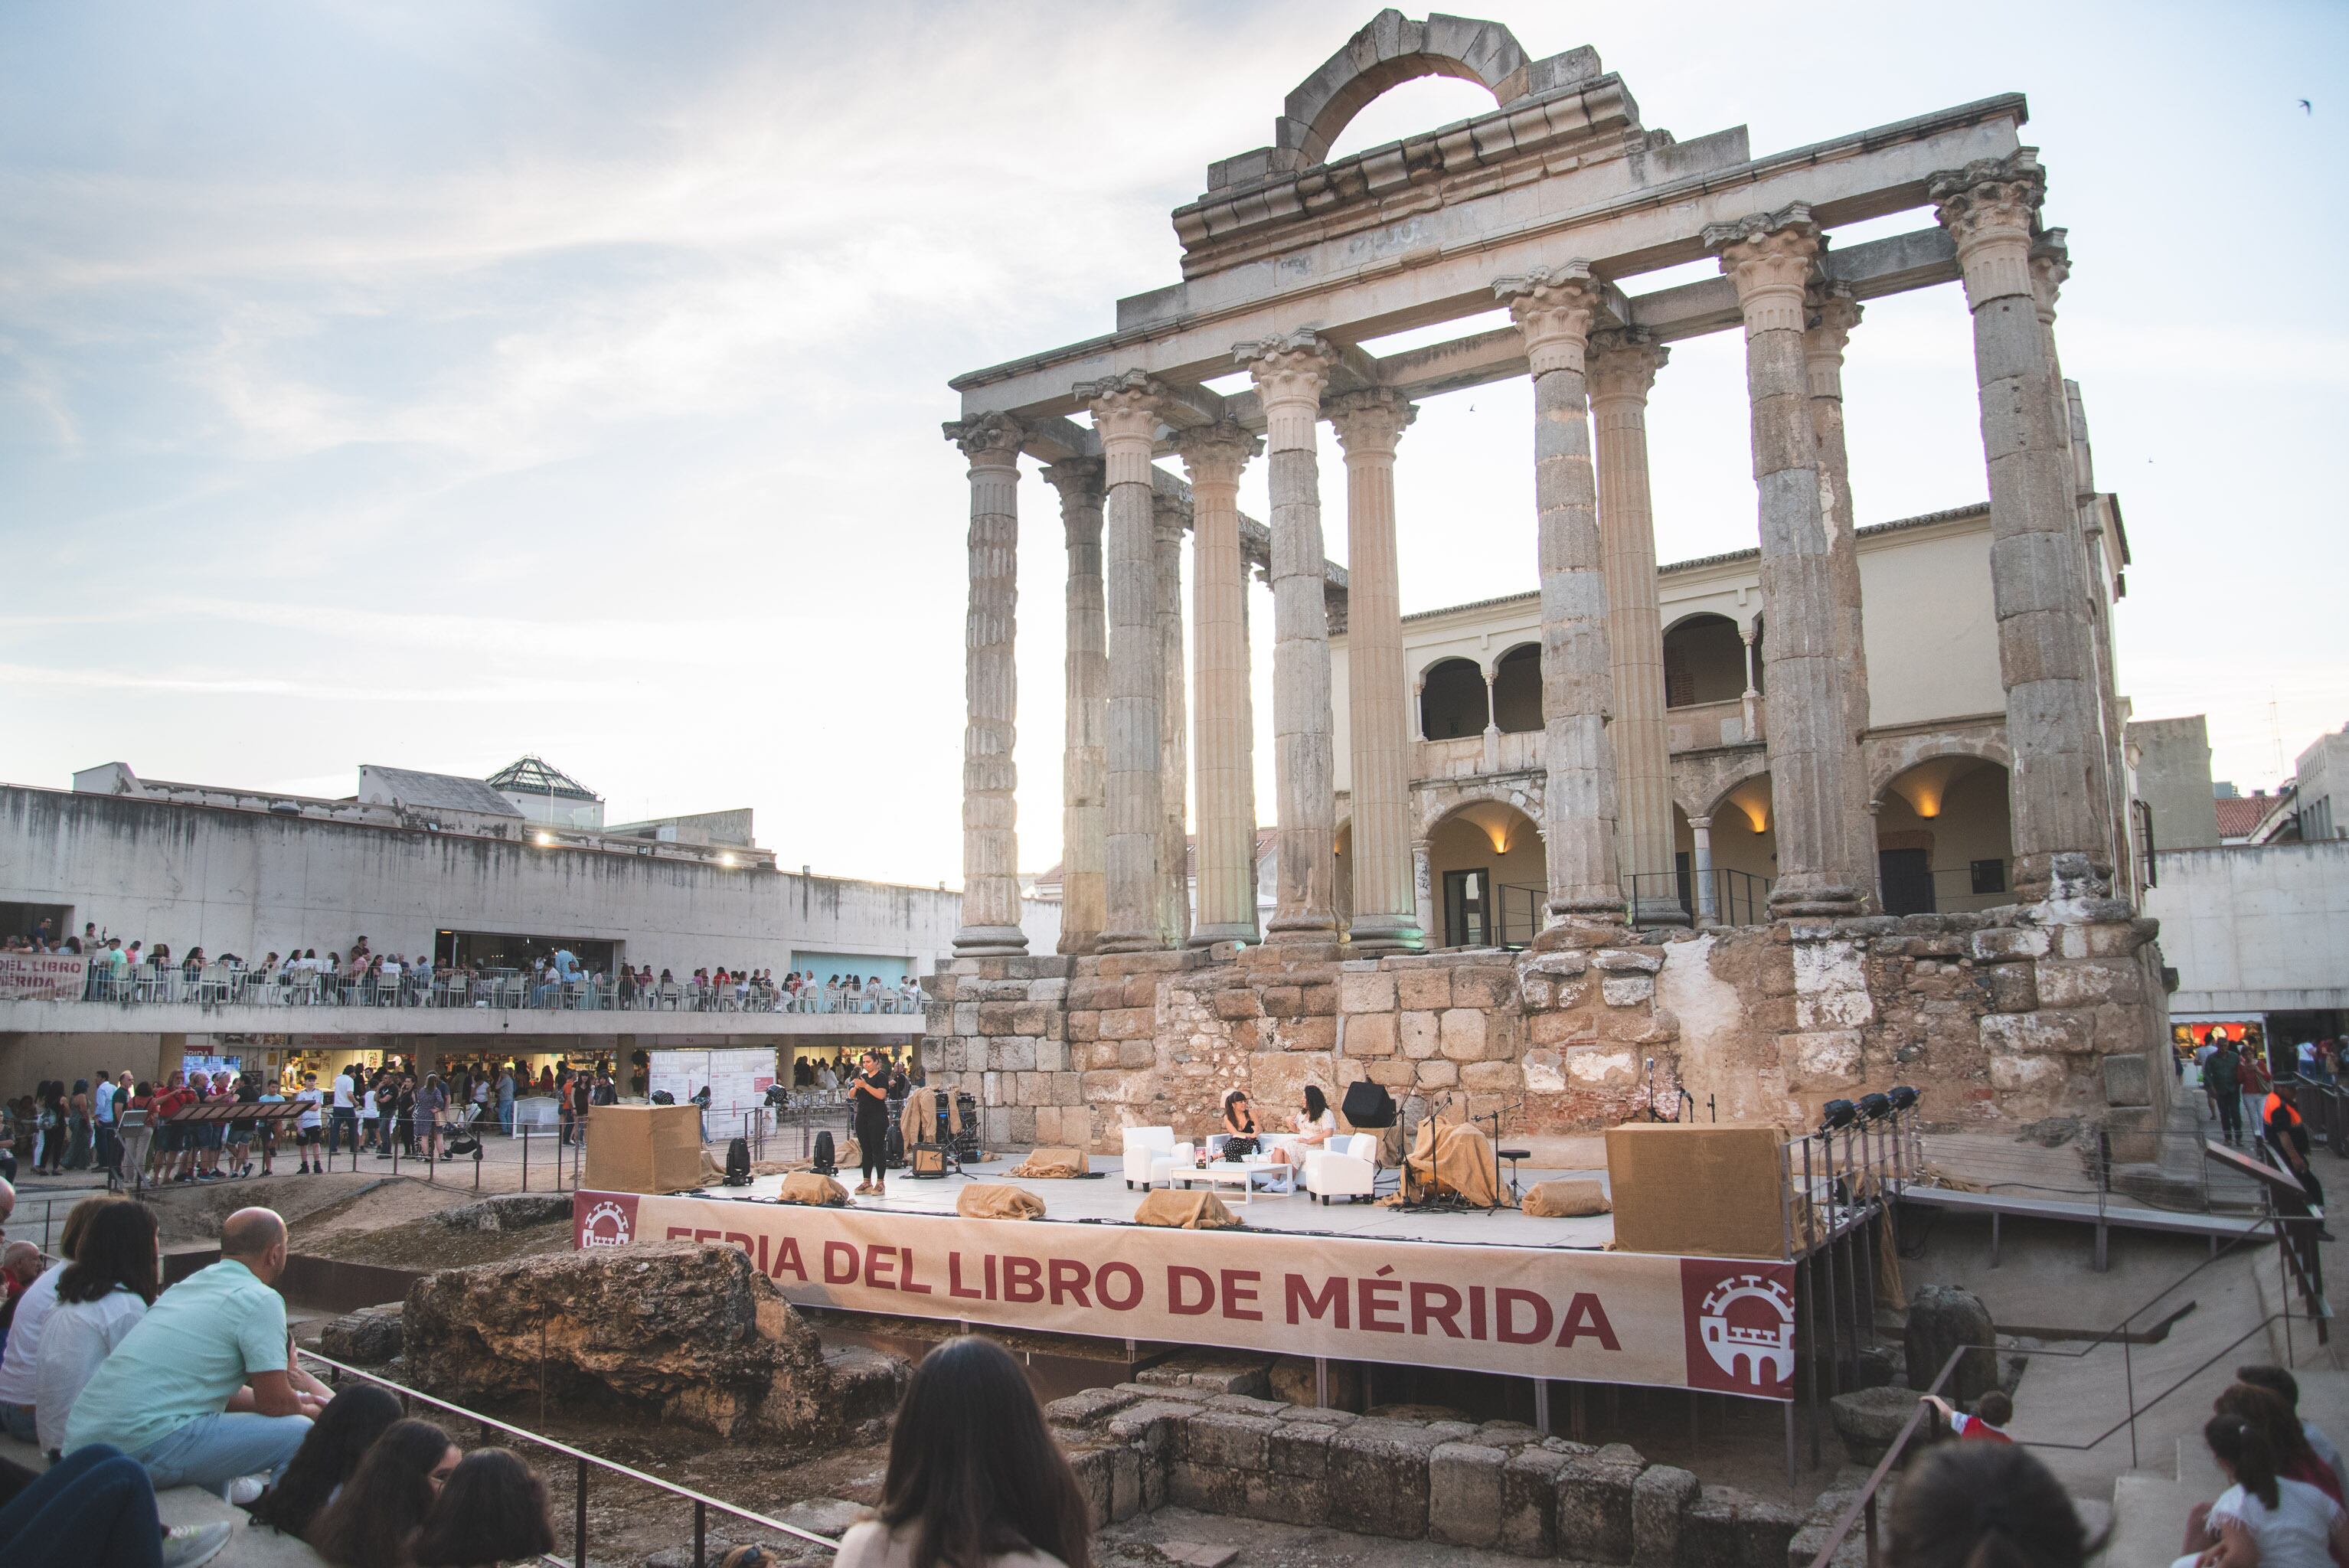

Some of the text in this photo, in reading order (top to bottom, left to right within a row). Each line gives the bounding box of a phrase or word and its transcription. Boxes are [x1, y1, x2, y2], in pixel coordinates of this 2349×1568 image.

[33, 961, 81, 973] LIBRO
[822, 1240, 933, 1295] DEL
[949, 1251, 1145, 1312] LIBRO
[1167, 1265, 1263, 1322] DE
[1285, 1263, 1622, 1351] MÉRIDA
